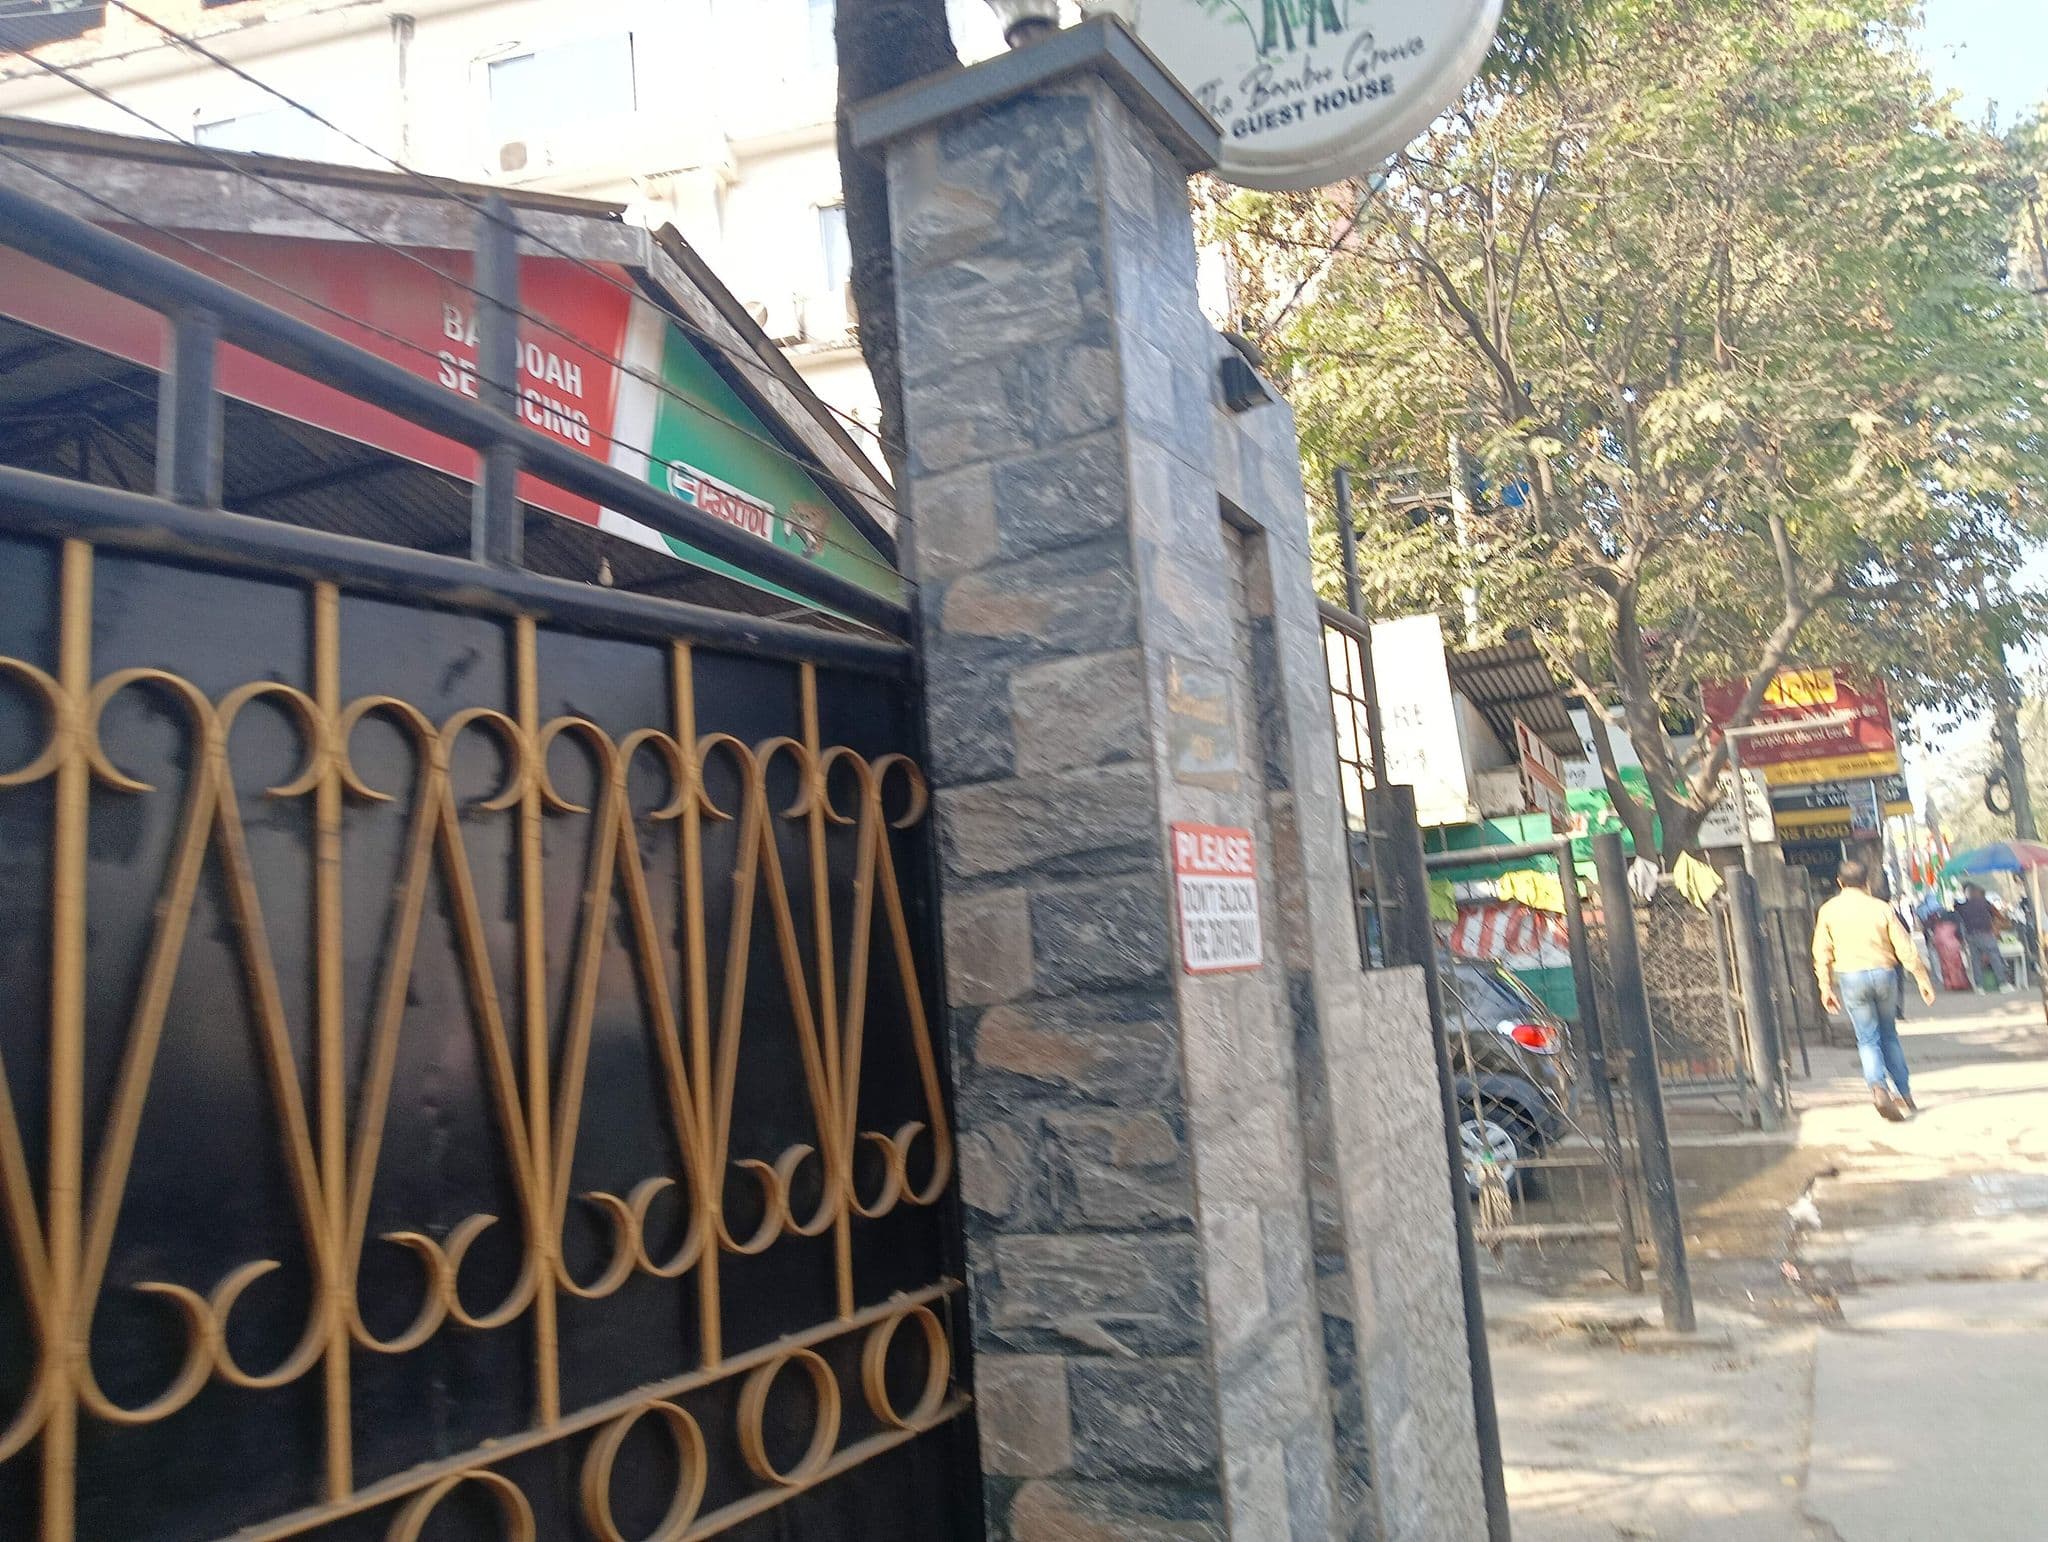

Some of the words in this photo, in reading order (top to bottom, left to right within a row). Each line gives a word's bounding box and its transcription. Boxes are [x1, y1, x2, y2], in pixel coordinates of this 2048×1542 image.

[1231, 101, 1308, 138] GUEST
[1313, 73, 1396, 116] HOUSE
[442, 302, 583, 399] BAOAH
[437, 350, 591, 447] SEICING
[697, 477, 769, 539] Castrol
[1176, 831, 1253, 873] PLEASE
